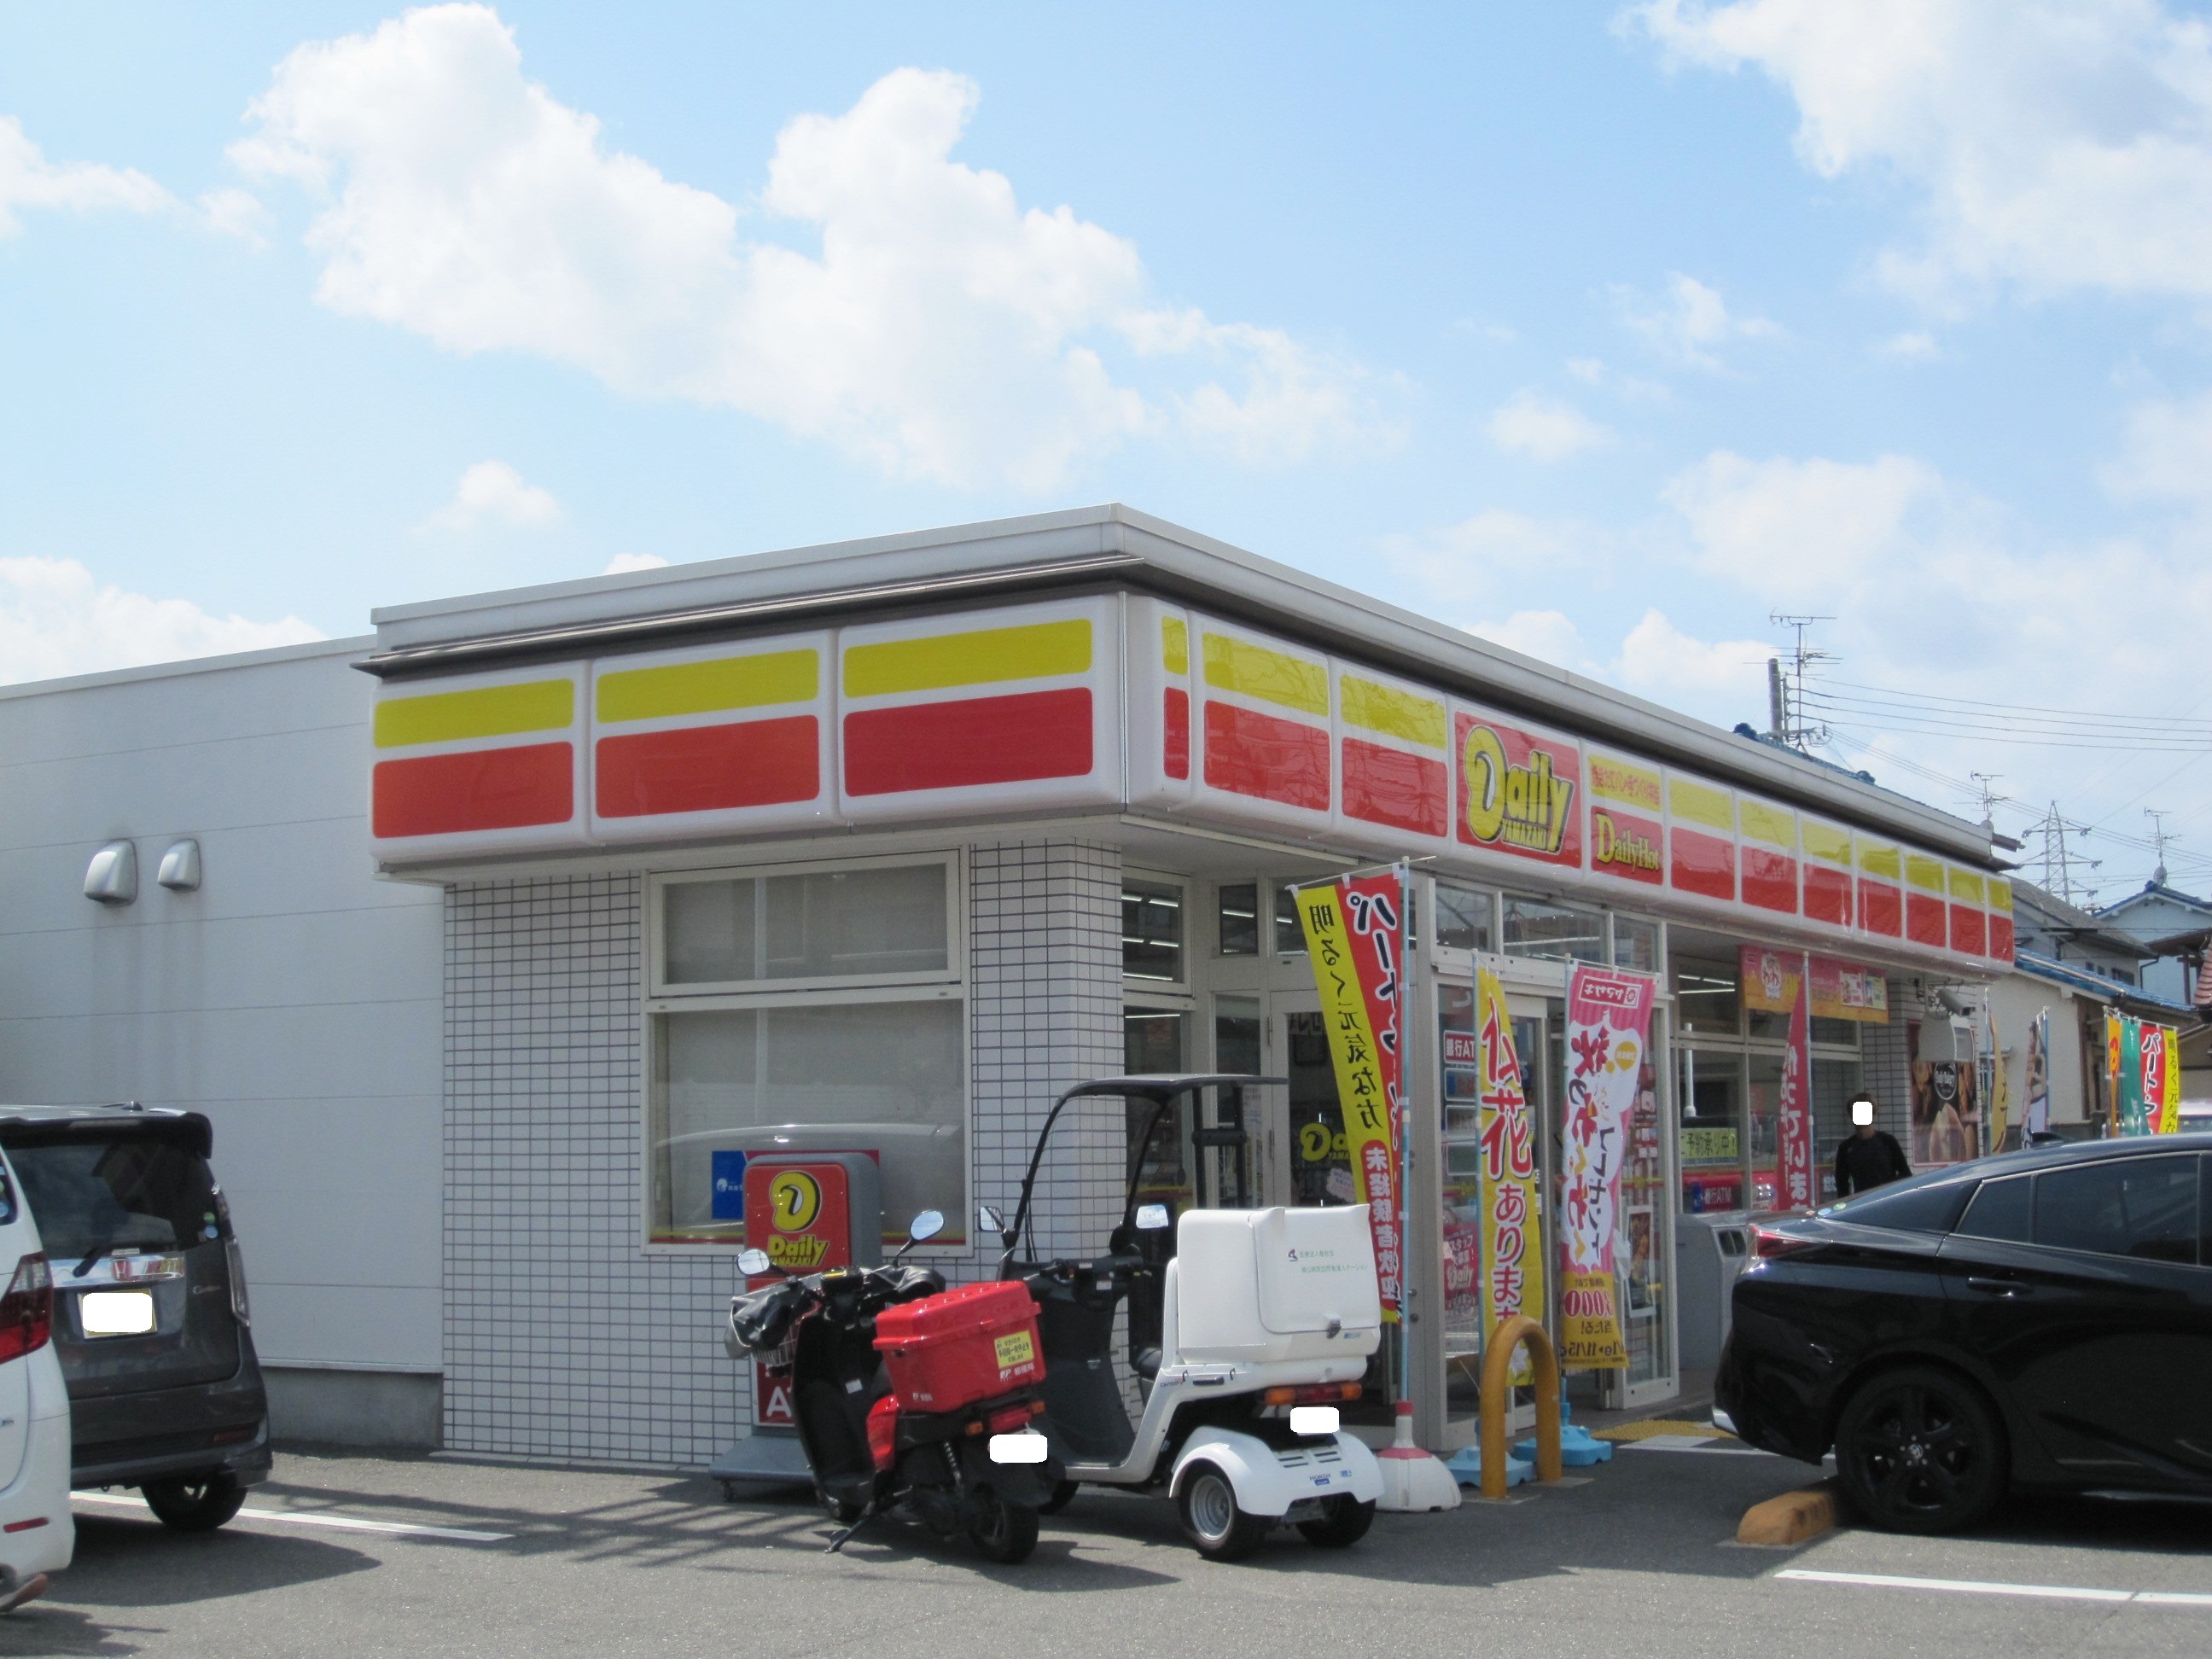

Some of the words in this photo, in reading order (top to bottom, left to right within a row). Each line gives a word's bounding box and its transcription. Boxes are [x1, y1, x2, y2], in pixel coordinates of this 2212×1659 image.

[1465, 726, 1574, 853] Daily
[1502, 818, 1547, 850] YAMAZAKI
[1446, 1038, 1475, 1059] 銀行AT
[769, 1235, 829, 1266] Daily
[766, 1386, 792, 1417] A
